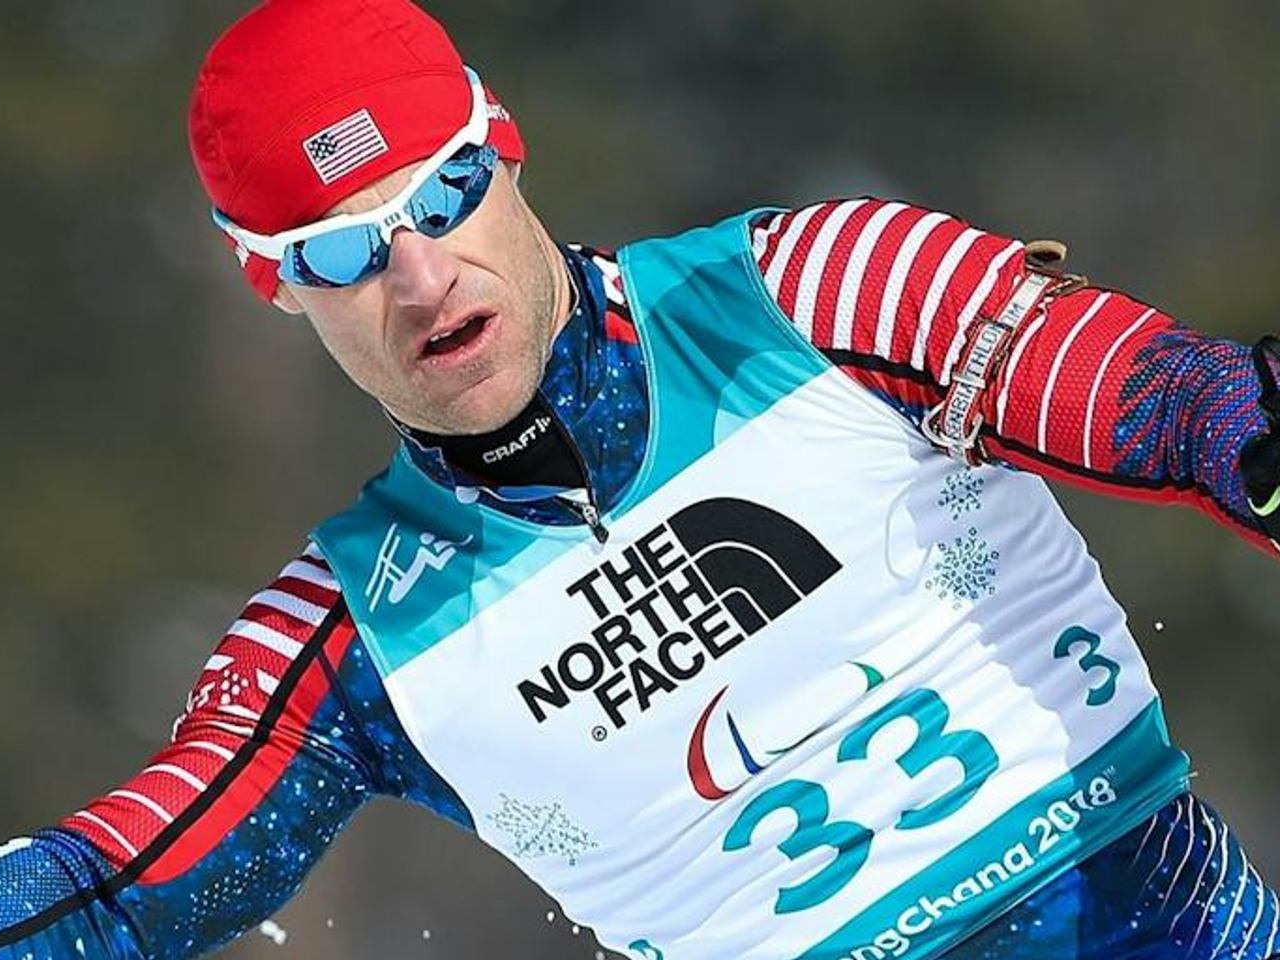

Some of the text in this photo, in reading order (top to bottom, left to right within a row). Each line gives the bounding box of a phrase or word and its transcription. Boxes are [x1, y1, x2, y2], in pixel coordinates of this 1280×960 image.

[482, 425, 537, 464] CRAFT
[565, 523, 687, 620] THE
[517, 563, 715, 724] NORTH
[593, 602, 745, 729] FACE
[1053, 625, 1121, 706] 3
[722, 688, 1000, 915] 33
[1028, 776, 1117, 851] 2018
